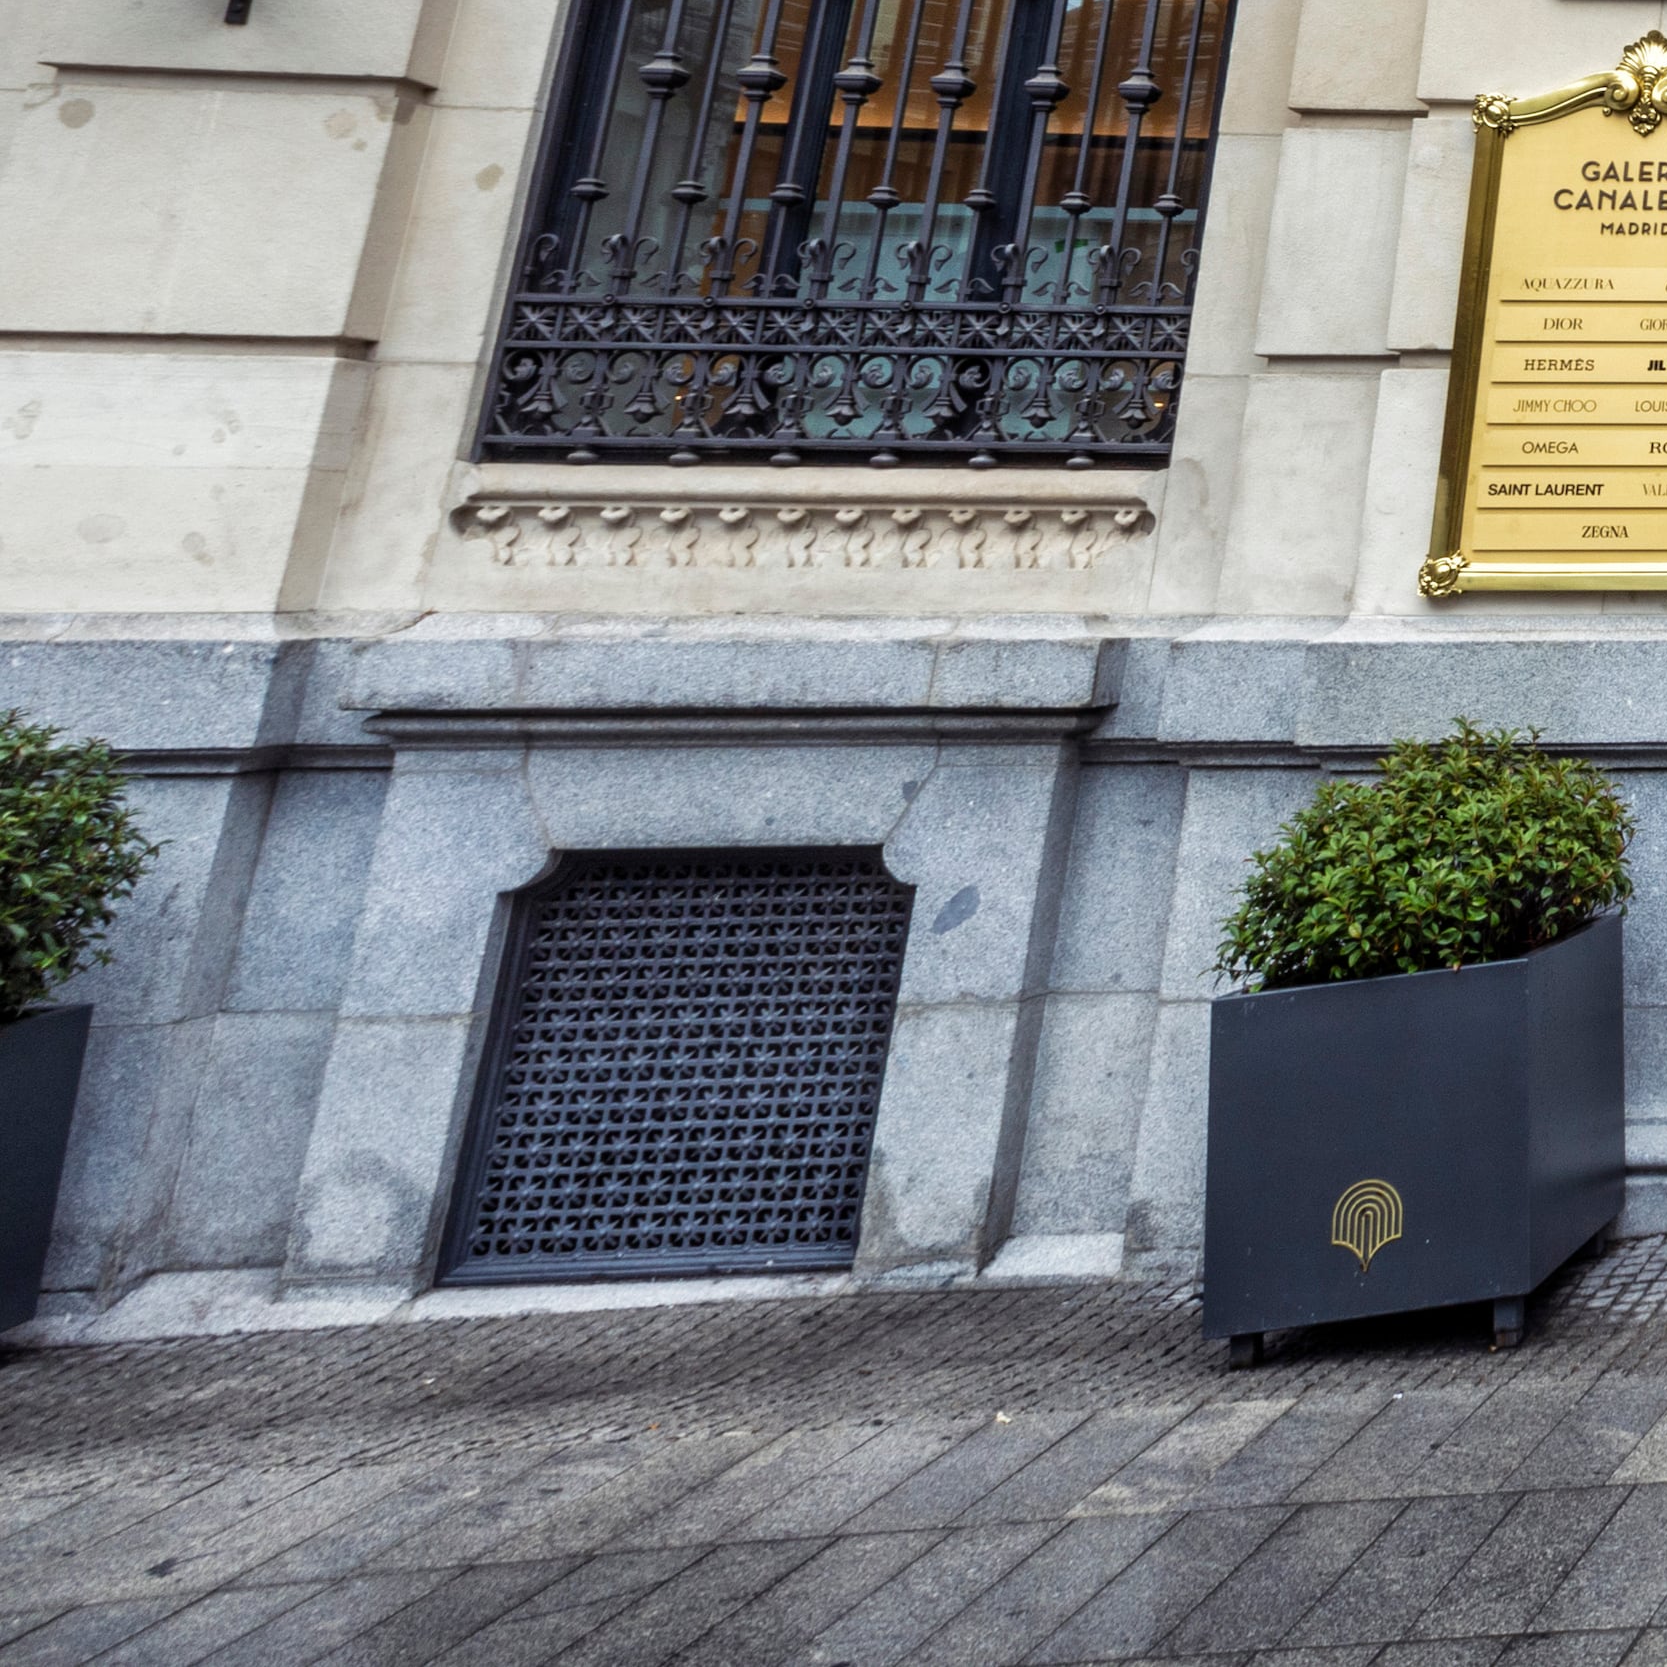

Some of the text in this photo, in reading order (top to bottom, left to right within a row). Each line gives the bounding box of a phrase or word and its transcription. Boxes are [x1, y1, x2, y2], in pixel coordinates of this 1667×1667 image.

[1520, 277, 1615, 292] AQUAZZURA
[1543, 317, 1584, 331] DIOR
[1647, 359, 1666, 372] JIL
[1512, 399, 1598, 413] JIMMY CHOO
[1521, 441, 1580, 455] OMEGA
[1487, 484, 1605, 496] SAINT LAURENT
[1581, 525, 1629, 539] ZEGNA
